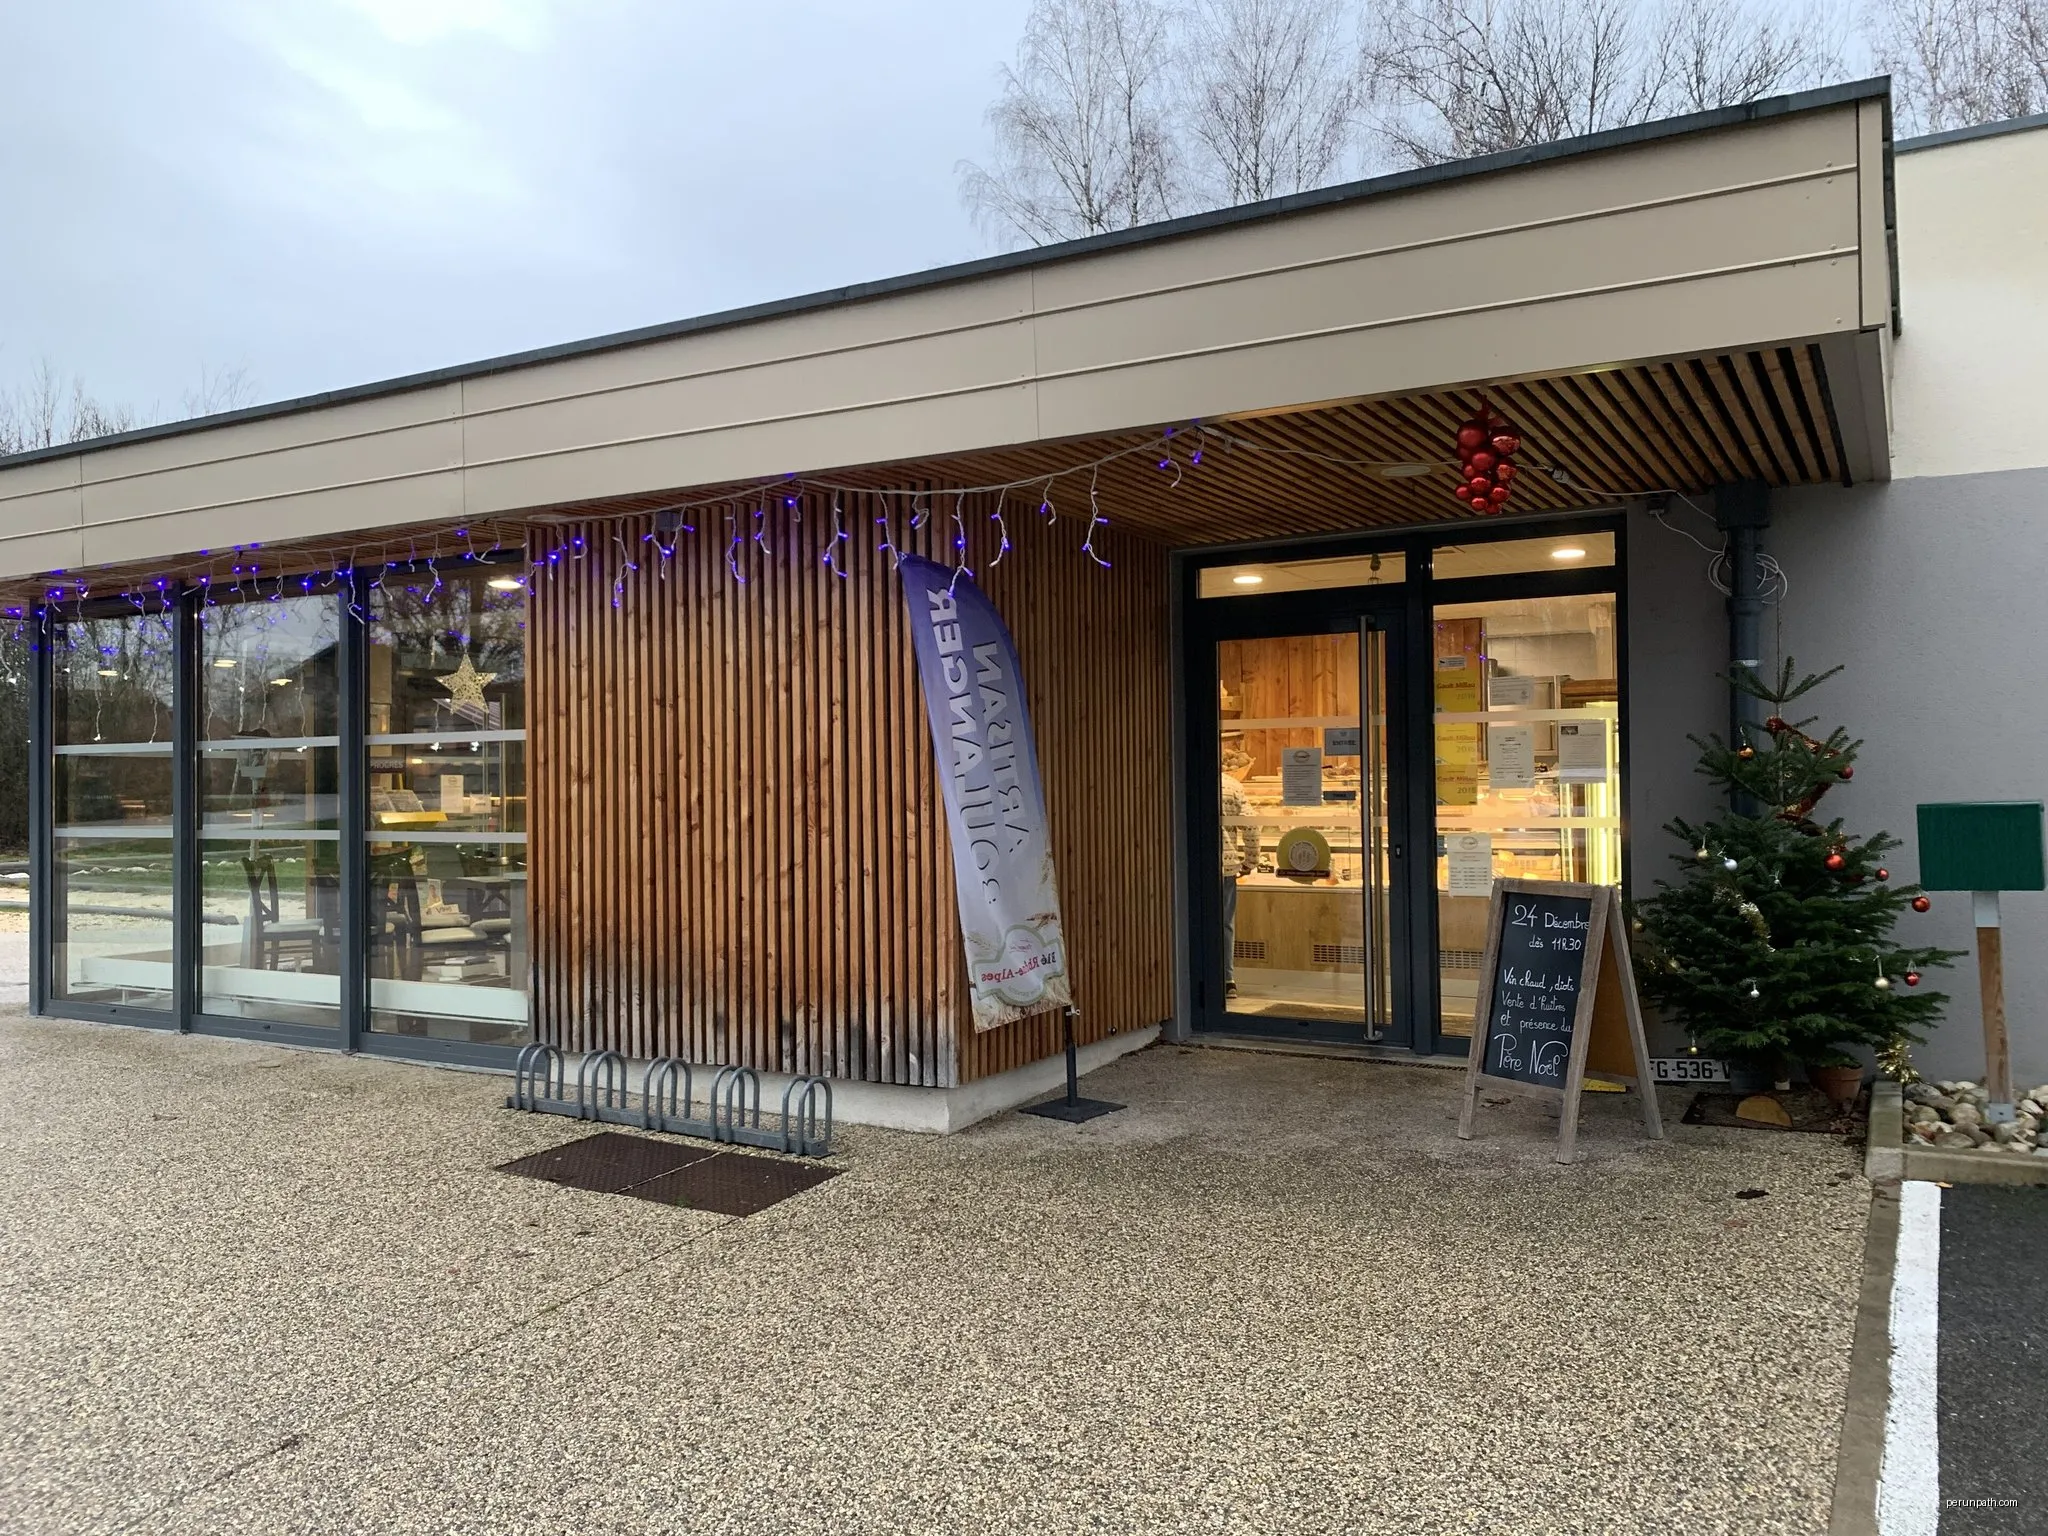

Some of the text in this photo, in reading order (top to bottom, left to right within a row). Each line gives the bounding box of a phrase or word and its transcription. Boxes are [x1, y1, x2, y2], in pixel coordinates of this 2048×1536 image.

[1511, 904, 1590, 929] 24 Décembre
[1503, 966, 1517, 985] Vin
[1518, 969, 1546, 989] chaud
[1502, 990, 1525, 1009] Vente
[1500, 1009, 1574, 1034] et présence du
[1493, 1033, 1569, 1077] Père Noël
